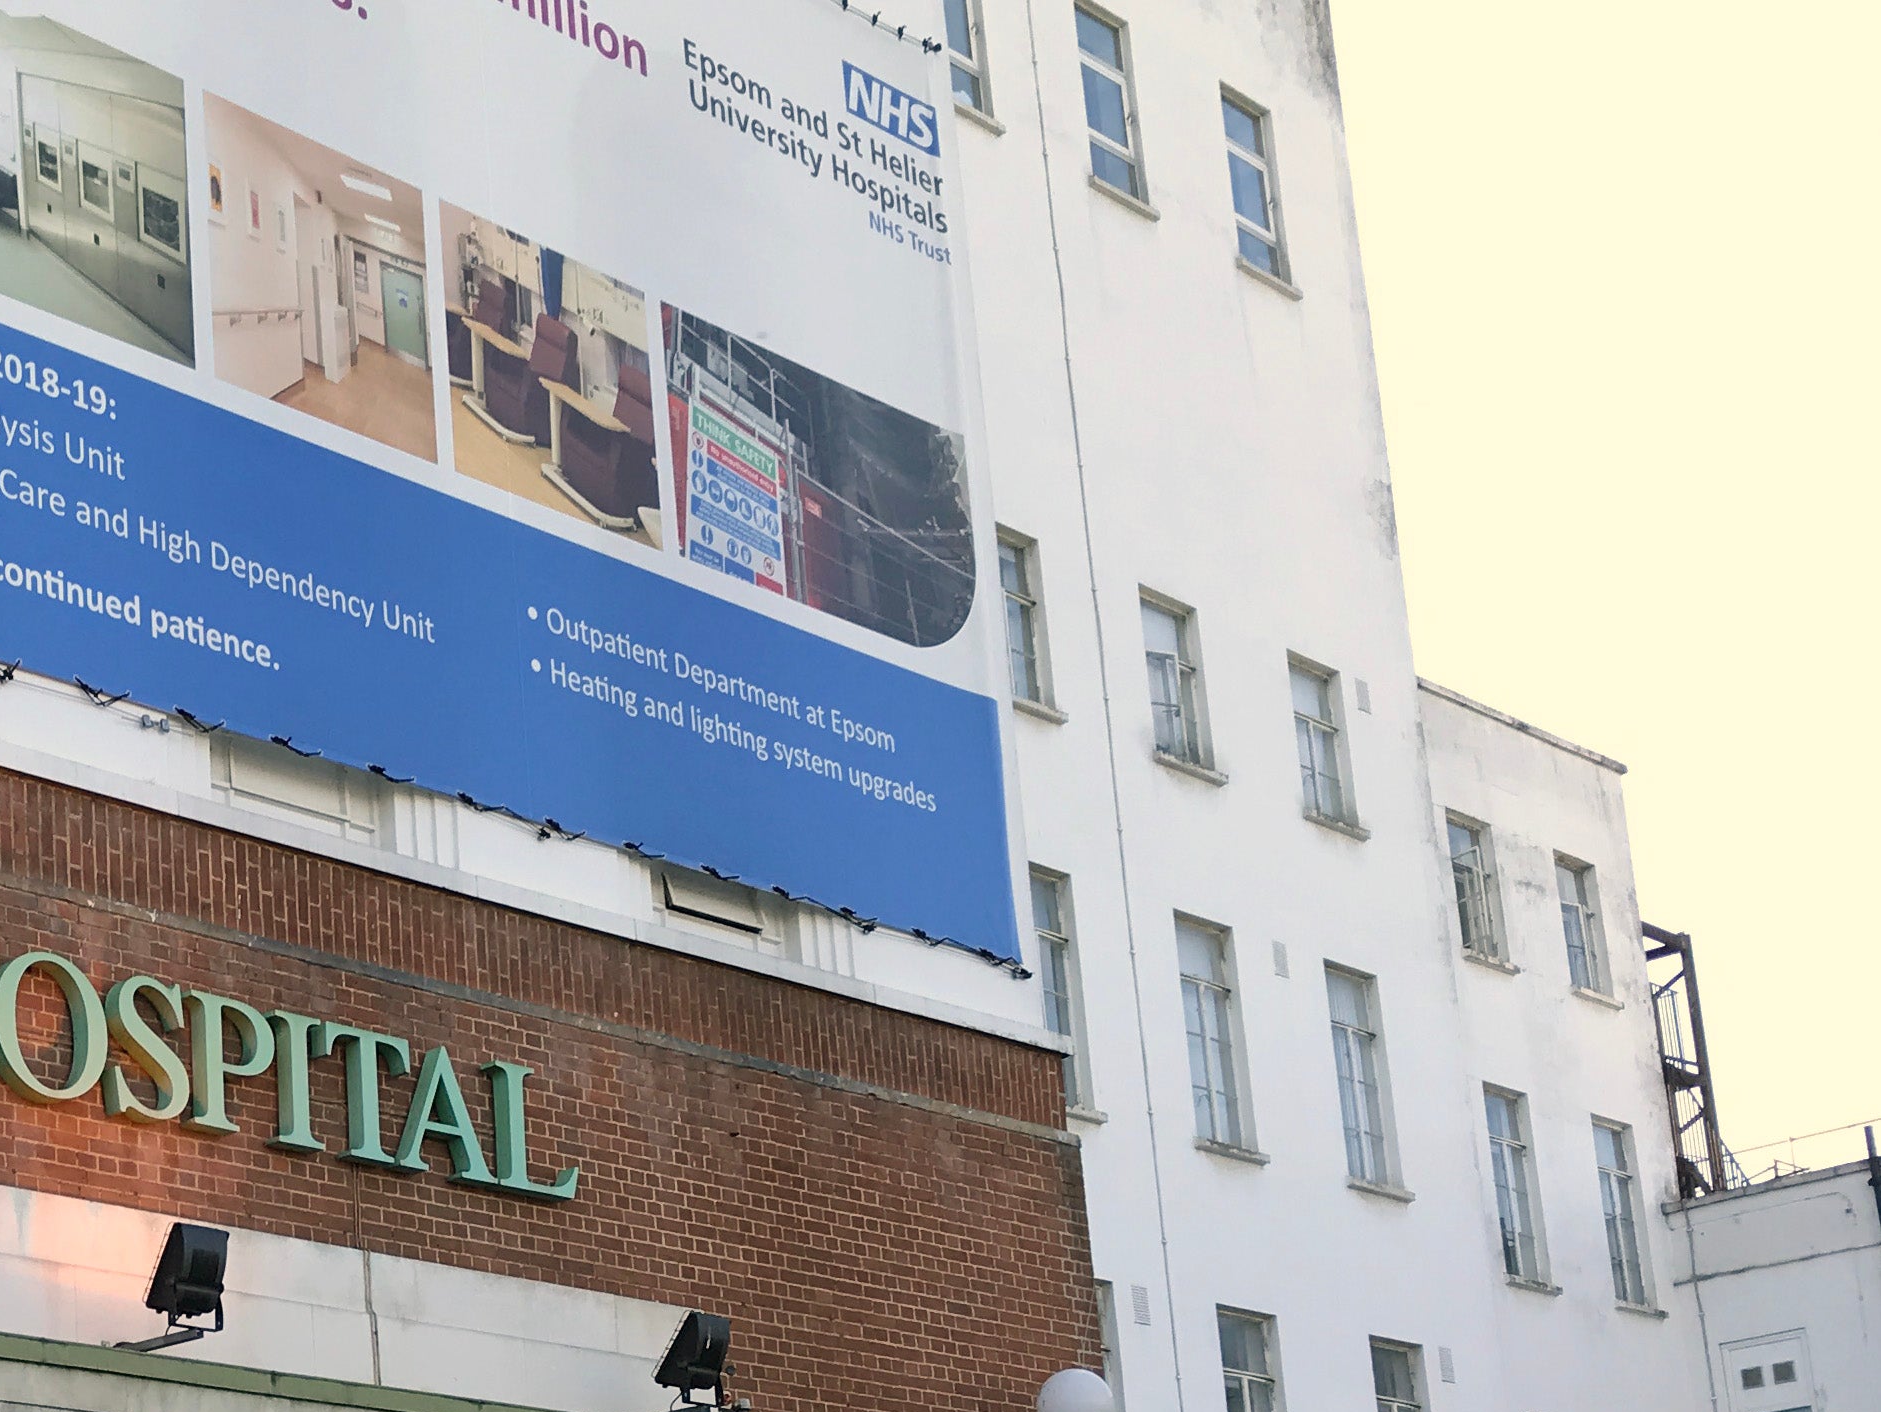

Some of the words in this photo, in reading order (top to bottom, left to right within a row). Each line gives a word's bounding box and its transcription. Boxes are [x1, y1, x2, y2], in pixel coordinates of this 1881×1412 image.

[684, 38, 771, 110] Epsom
[782, 98, 828, 140] and
[837, 123, 862, 158] St
[870, 136, 943, 197] Helier
[689, 78, 822, 176] University
[832, 158, 947, 235] Hospitals
[848, 66, 935, 148] NHS
[869, 211, 904, 243] NHS
[909, 226, 951, 265] Trust
[66, 432, 125, 480] Unit
[734, 441, 773, 475] SAFETY
[0, 470, 65, 516] Care
[77, 502, 128, 538] and
[140, 516, 200, 563] High
[212, 542, 374, 627] Dependency
[384, 601, 434, 642] Unit
[151, 610, 279, 670] patience.
[547, 608, 668, 674] Outpatient
[674, 653, 800, 721] Department
[806, 706, 825, 728] at
[832, 710, 895, 752] Epsom
[551, 659, 637, 716] Heating
[645, 698, 683, 726] and
[691, 706, 768, 760] lighting
[774, 742, 842, 780] system
[849, 767, 936, 811] upgrades
